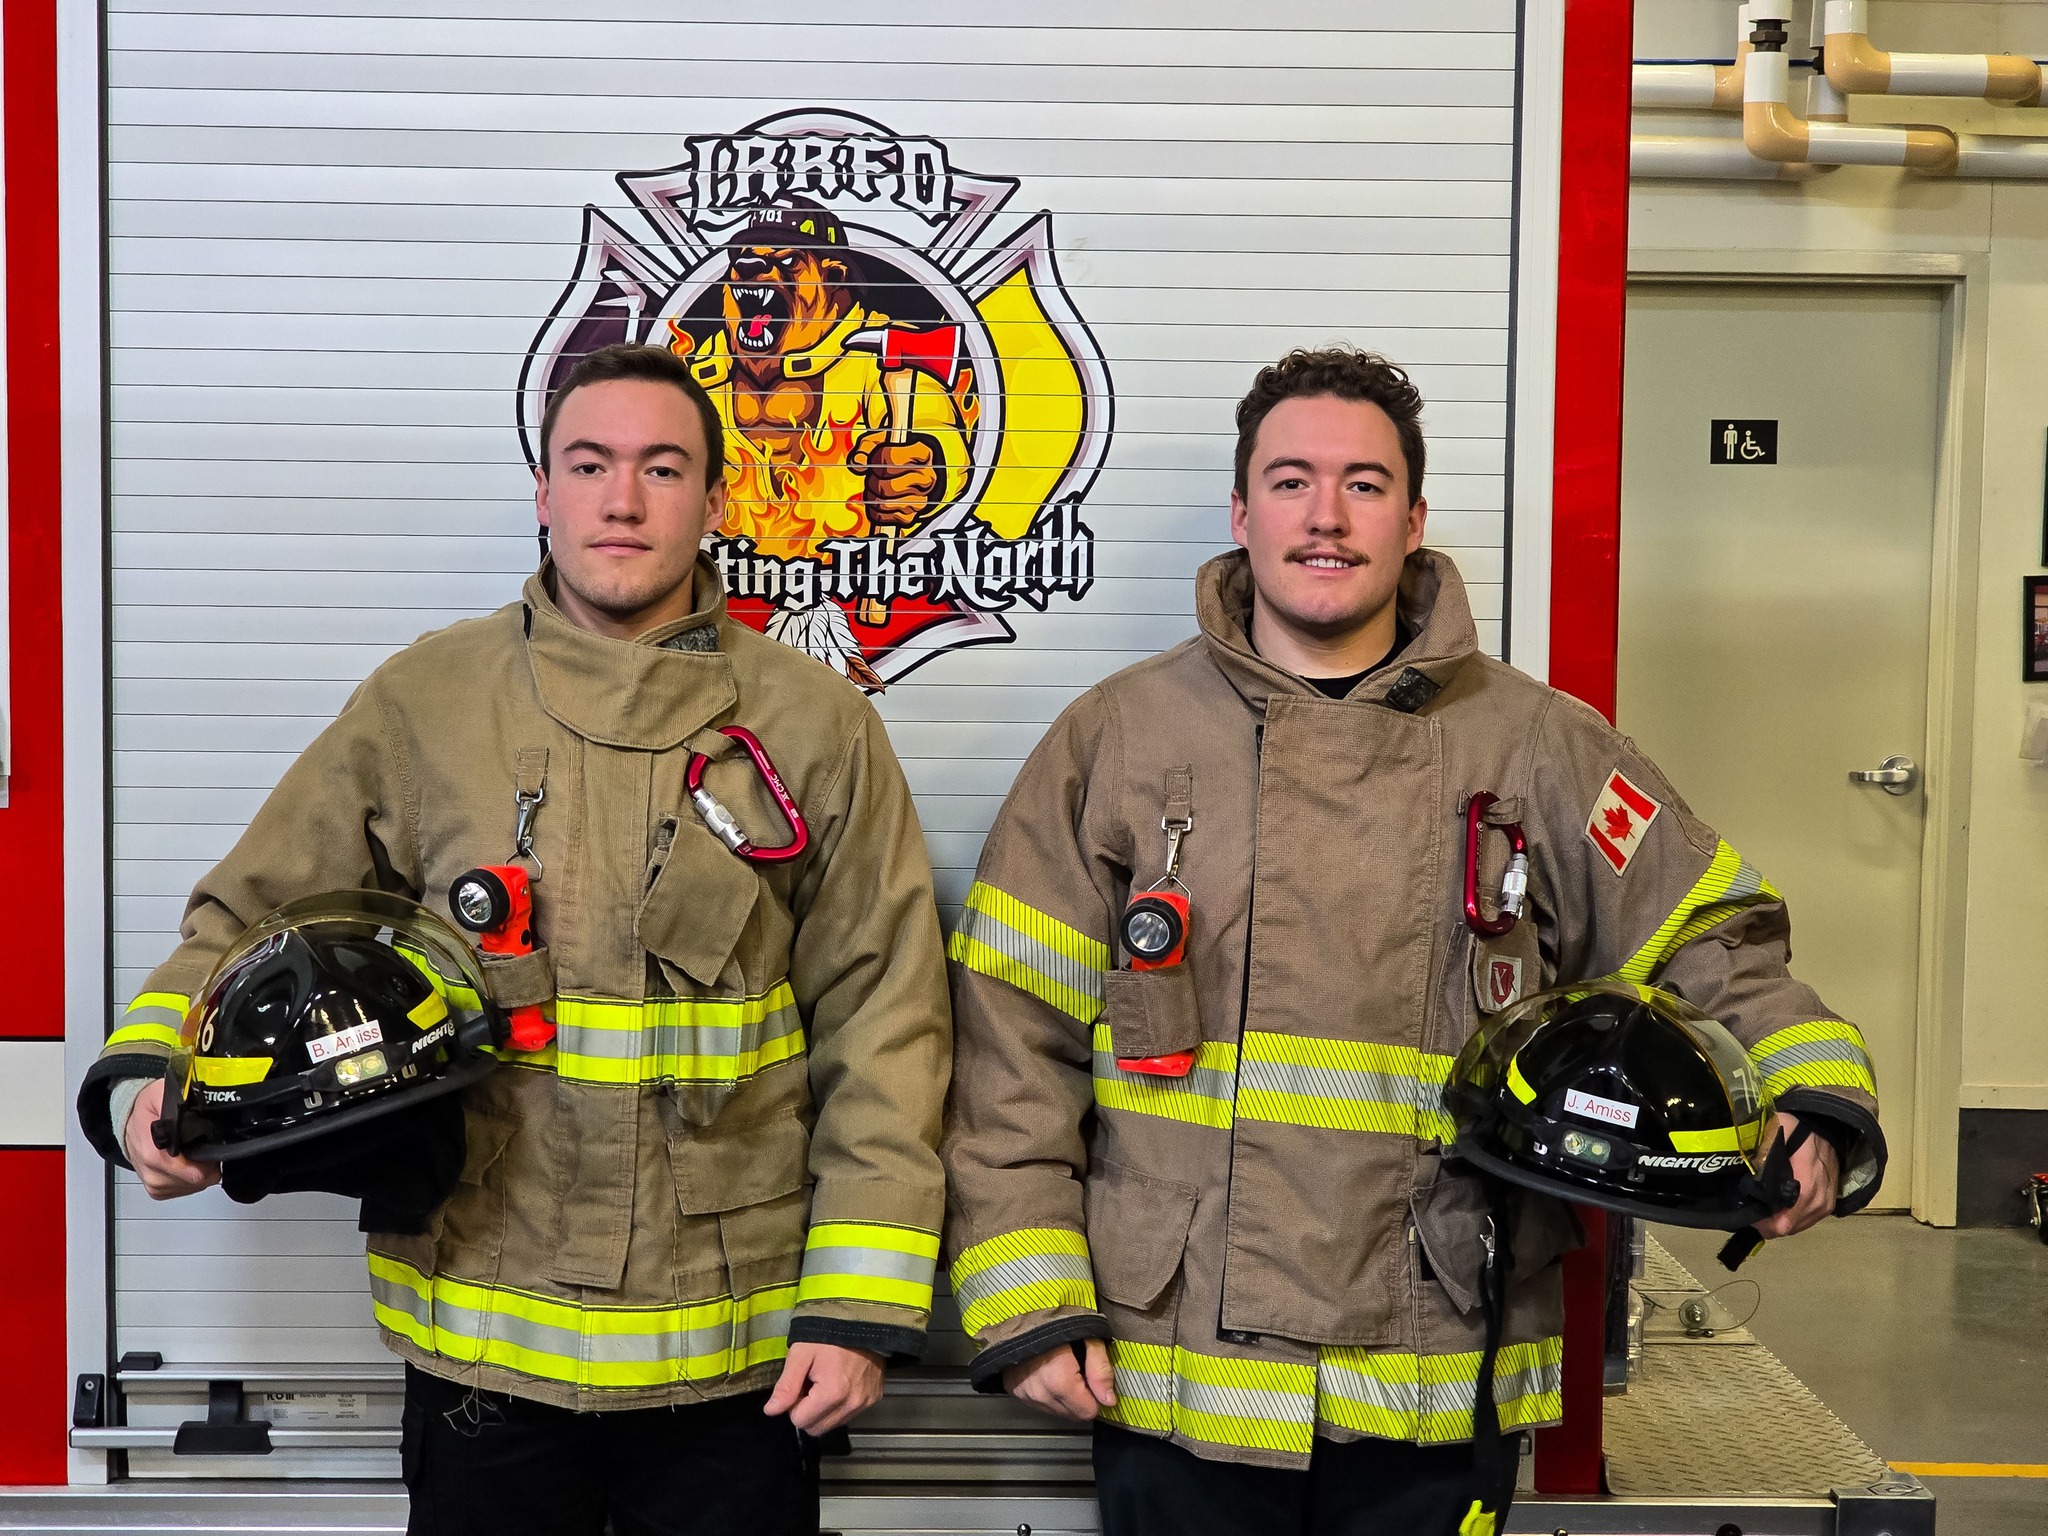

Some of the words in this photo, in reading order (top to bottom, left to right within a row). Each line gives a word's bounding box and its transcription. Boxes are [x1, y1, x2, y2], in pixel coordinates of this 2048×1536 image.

[759, 209, 783, 223] 701
[822, 539, 928, 602] The
[934, 500, 1094, 610] North
[1567, 1094, 1579, 1109] J.
[1584, 1099, 1631, 1122] Amiss
[1637, 1153, 1745, 1174] NIGHTSTIC
